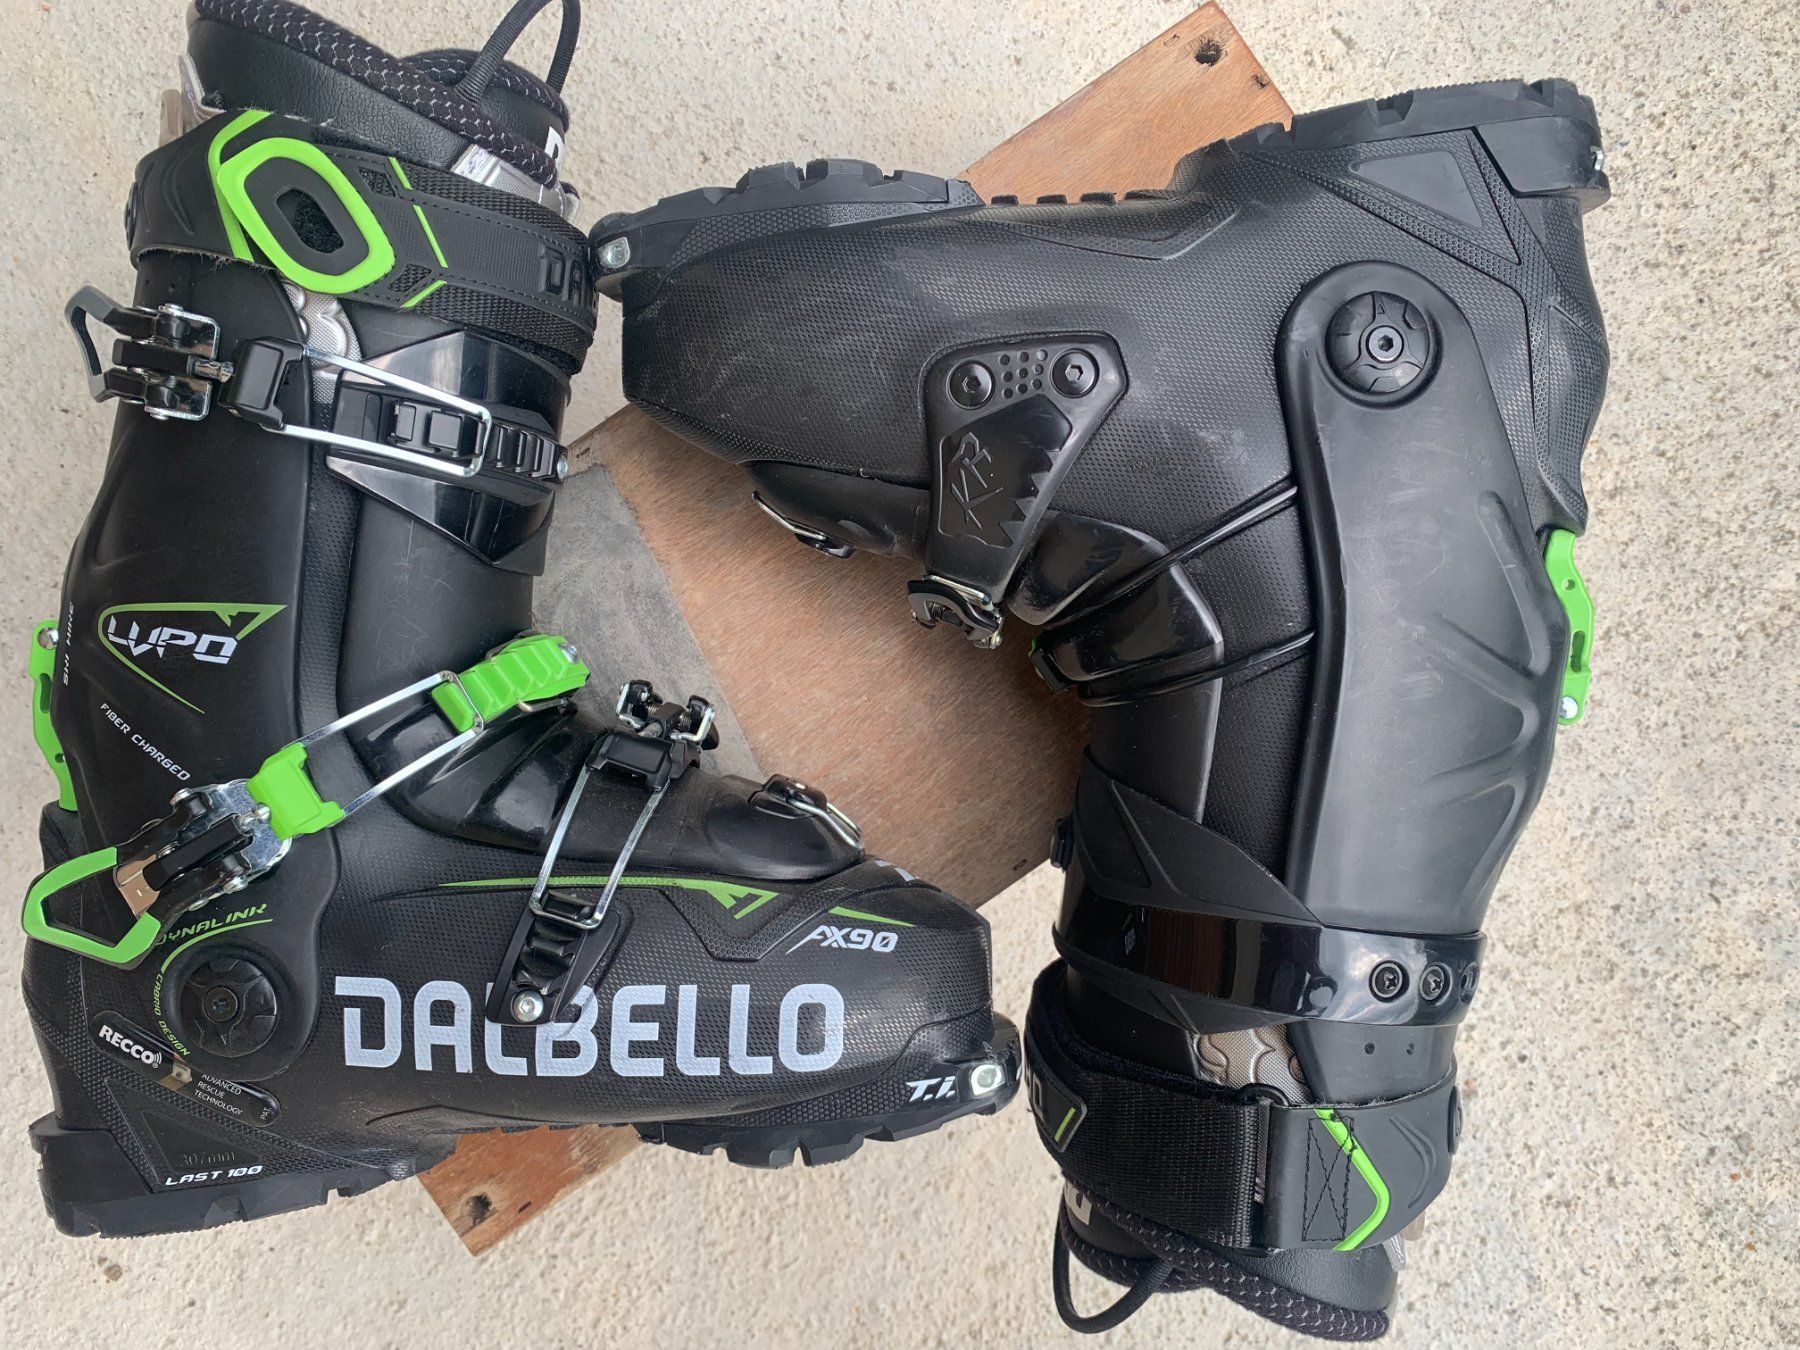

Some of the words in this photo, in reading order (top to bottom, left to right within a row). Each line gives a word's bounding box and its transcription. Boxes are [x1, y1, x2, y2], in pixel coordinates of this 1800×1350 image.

[101, 702, 130, 734] FIBER
[131, 733, 191, 782] CHARGED
[153, 973, 163, 1016] CABRIO
[158, 1020, 191, 1056] DESIGN
[335, 976, 845, 1077] DALBELLO
[99, 1024, 155, 1067] RECCO
[197, 1081, 226, 1099] RESCUE
[201, 1073, 242, 1096] ADVANCED
[194, 1089, 243, 1116] TECHNOLOGY
[165, 1170, 223, 1186] LAST
[227, 1165, 263, 1178] 100
